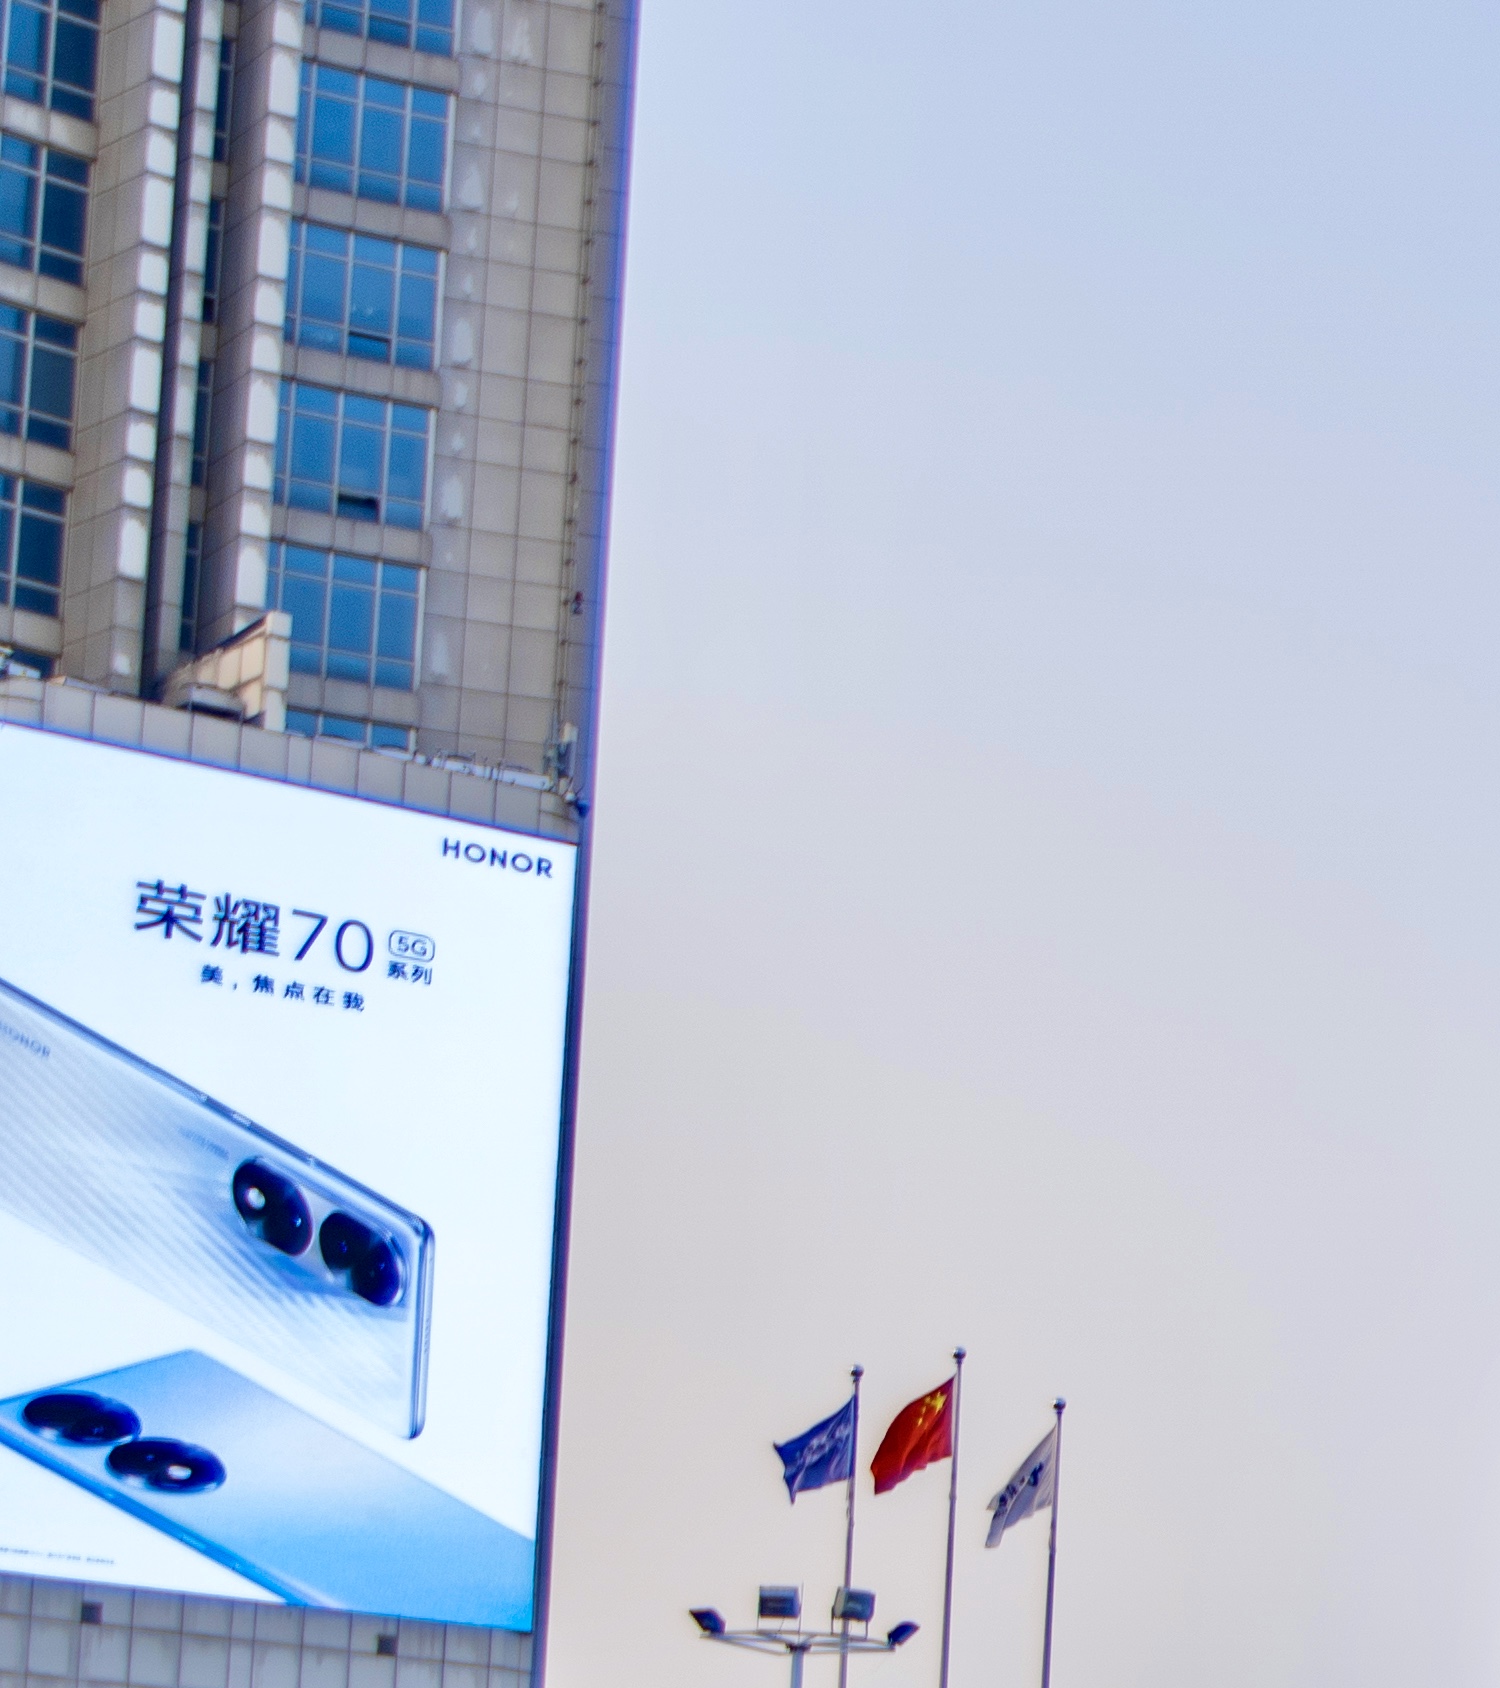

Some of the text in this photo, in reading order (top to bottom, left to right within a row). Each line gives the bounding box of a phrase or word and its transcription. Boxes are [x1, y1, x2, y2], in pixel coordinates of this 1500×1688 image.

[442, 836, 554, 879] HONOR
[134, 879, 374, 973] 荣耀70
[397, 934, 429, 957] 5G
[386, 960, 433, 986] 系列
